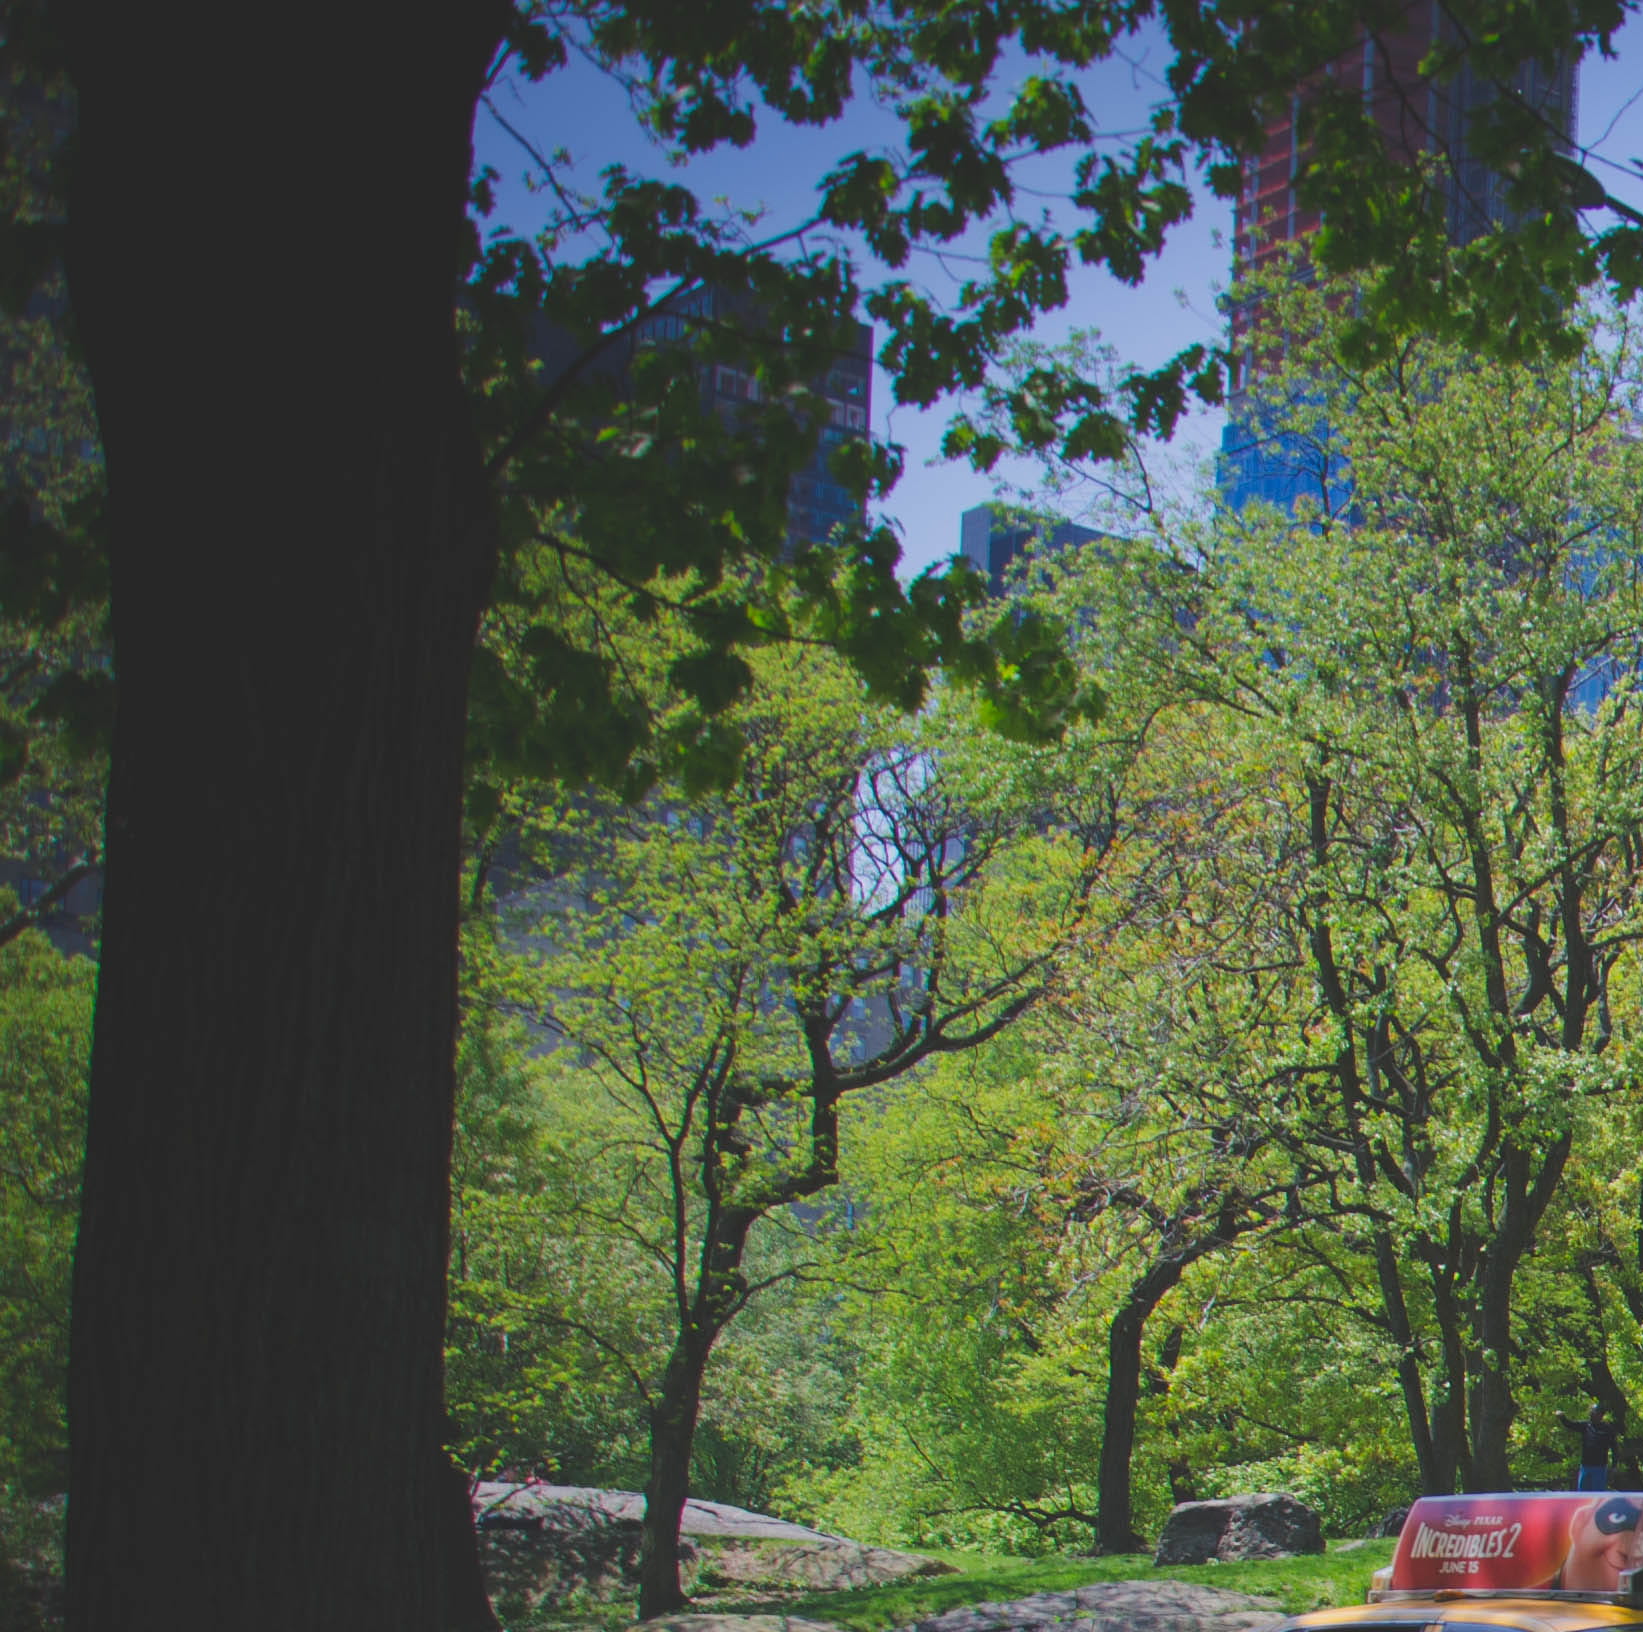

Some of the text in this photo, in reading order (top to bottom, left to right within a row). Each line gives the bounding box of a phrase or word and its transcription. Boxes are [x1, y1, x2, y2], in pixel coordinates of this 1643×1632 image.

[1474, 1516, 1503, 1525] PIXAR
[1410, 1521, 1522, 1558] INCREDIBLES 2
[1439, 1561, 1480, 1573] JUNE 15
